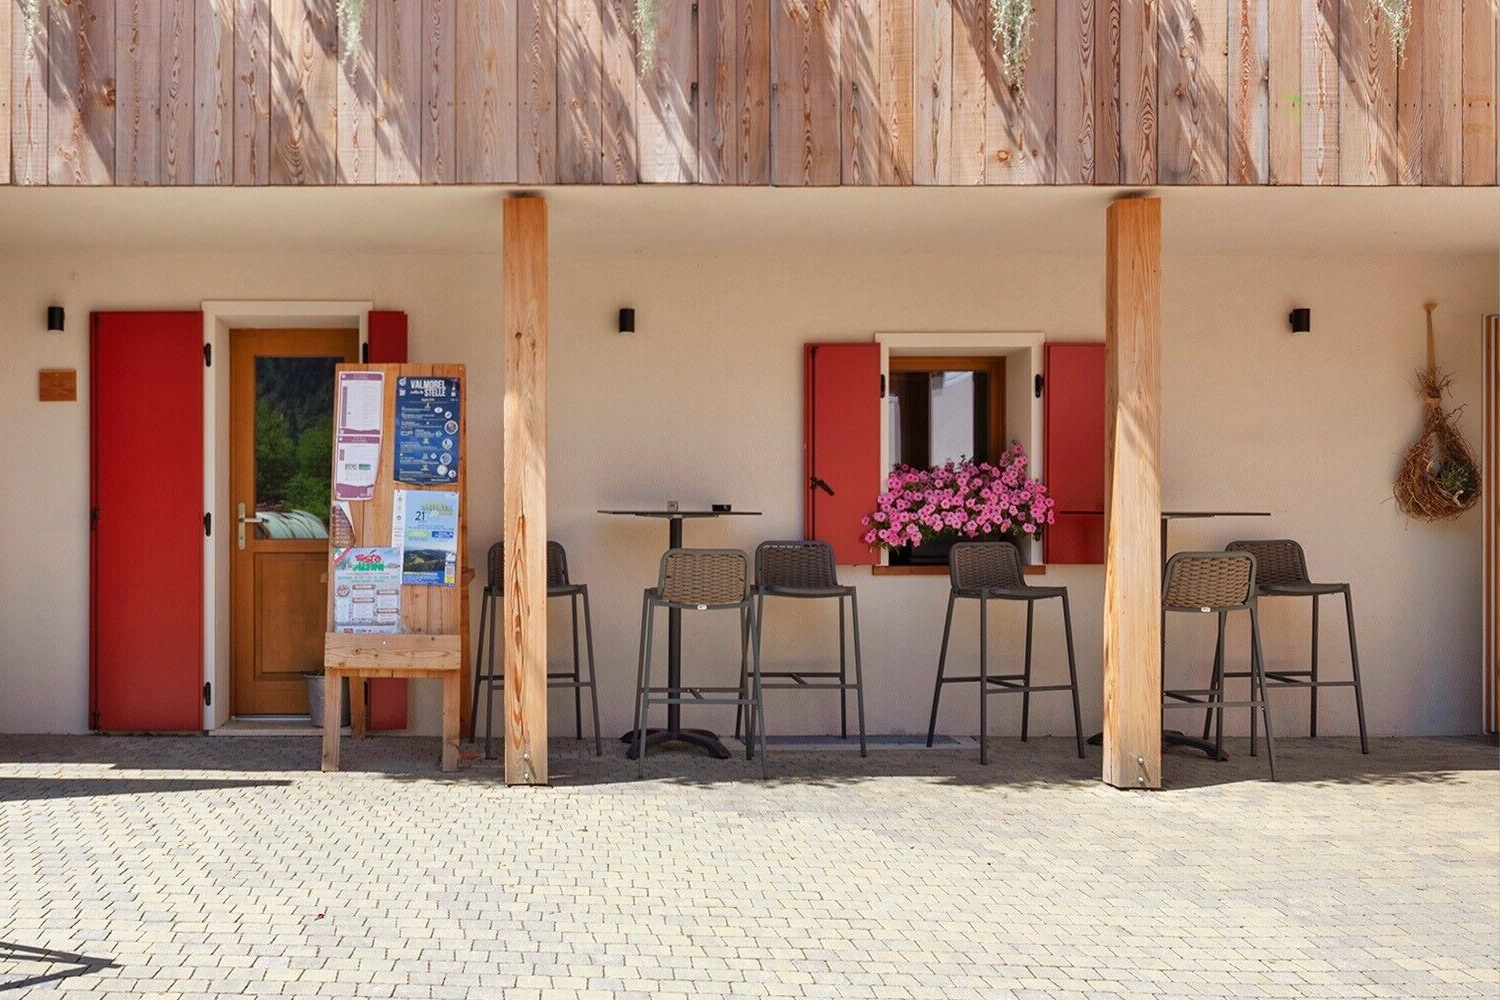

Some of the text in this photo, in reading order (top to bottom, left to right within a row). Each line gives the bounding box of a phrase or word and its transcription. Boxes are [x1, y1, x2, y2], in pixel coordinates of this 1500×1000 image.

[410, 380, 446, 391] VALMOREL
[424, 388, 446, 397] STELLE
[414, 510, 425, 521] 21
